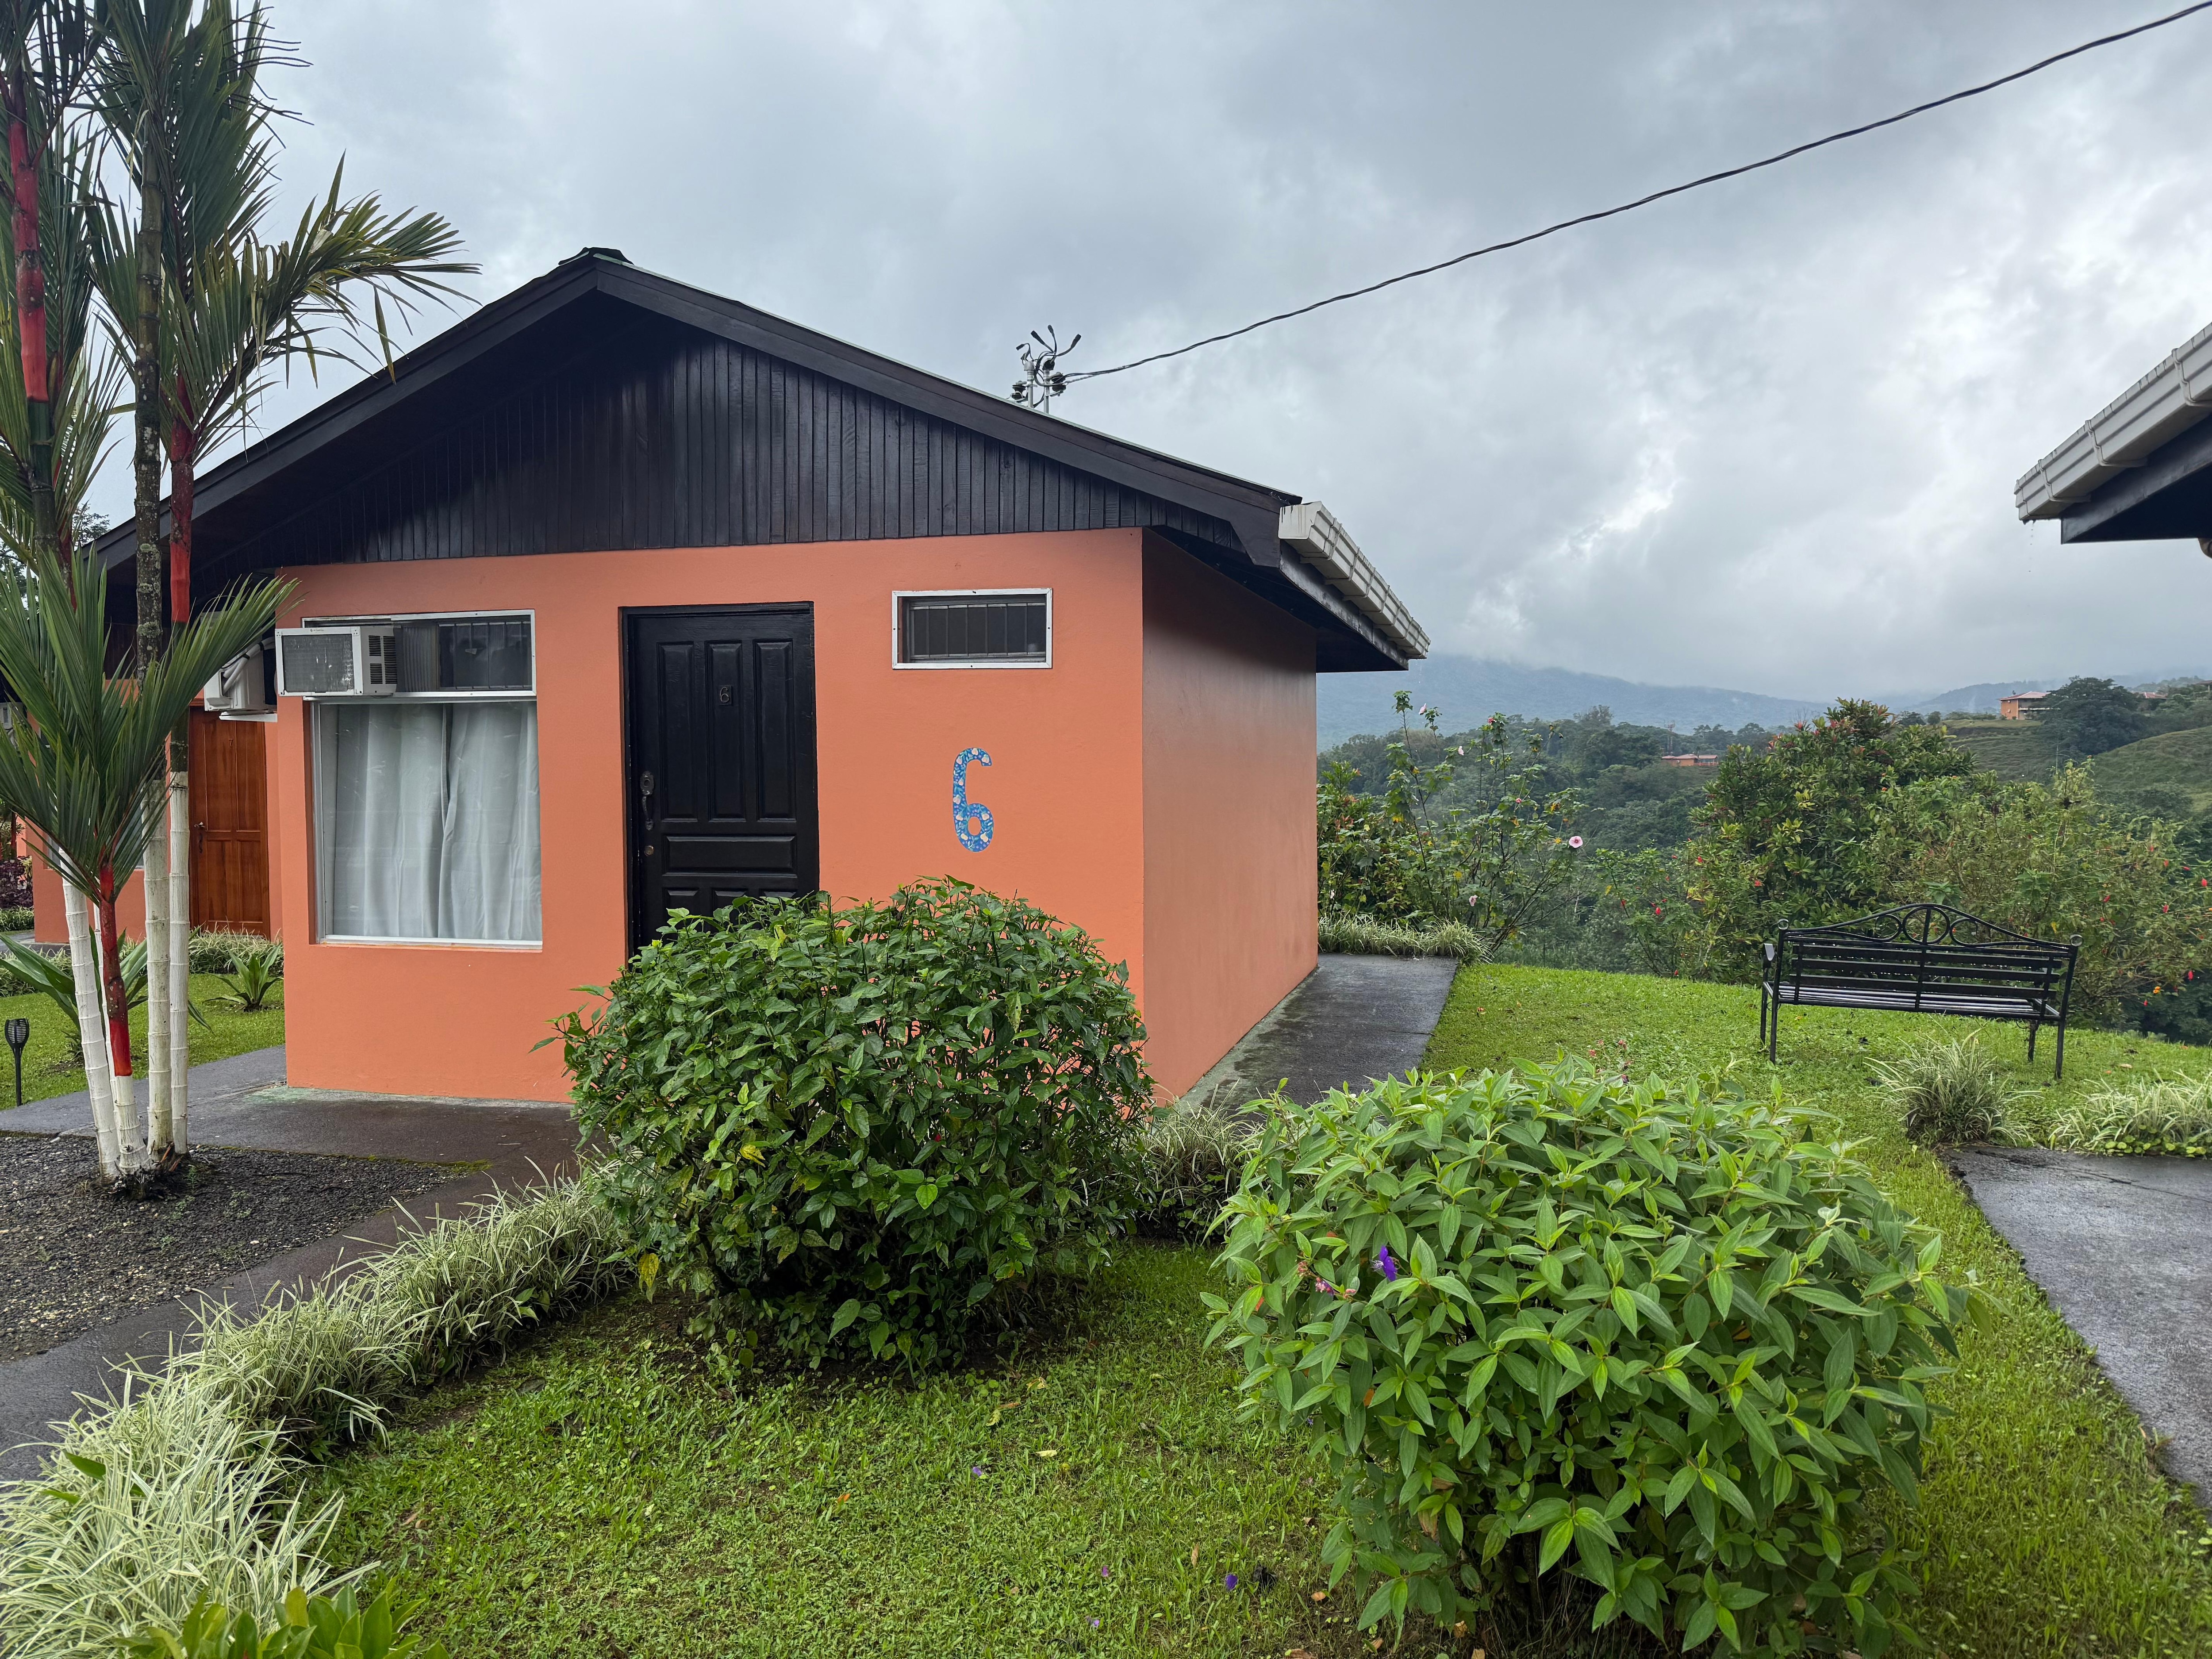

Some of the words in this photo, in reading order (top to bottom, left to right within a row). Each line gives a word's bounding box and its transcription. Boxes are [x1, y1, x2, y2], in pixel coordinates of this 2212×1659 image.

[720, 687, 729, 703] 6
[229, 738, 234, 747] 7
[952, 747, 994, 852] 6
